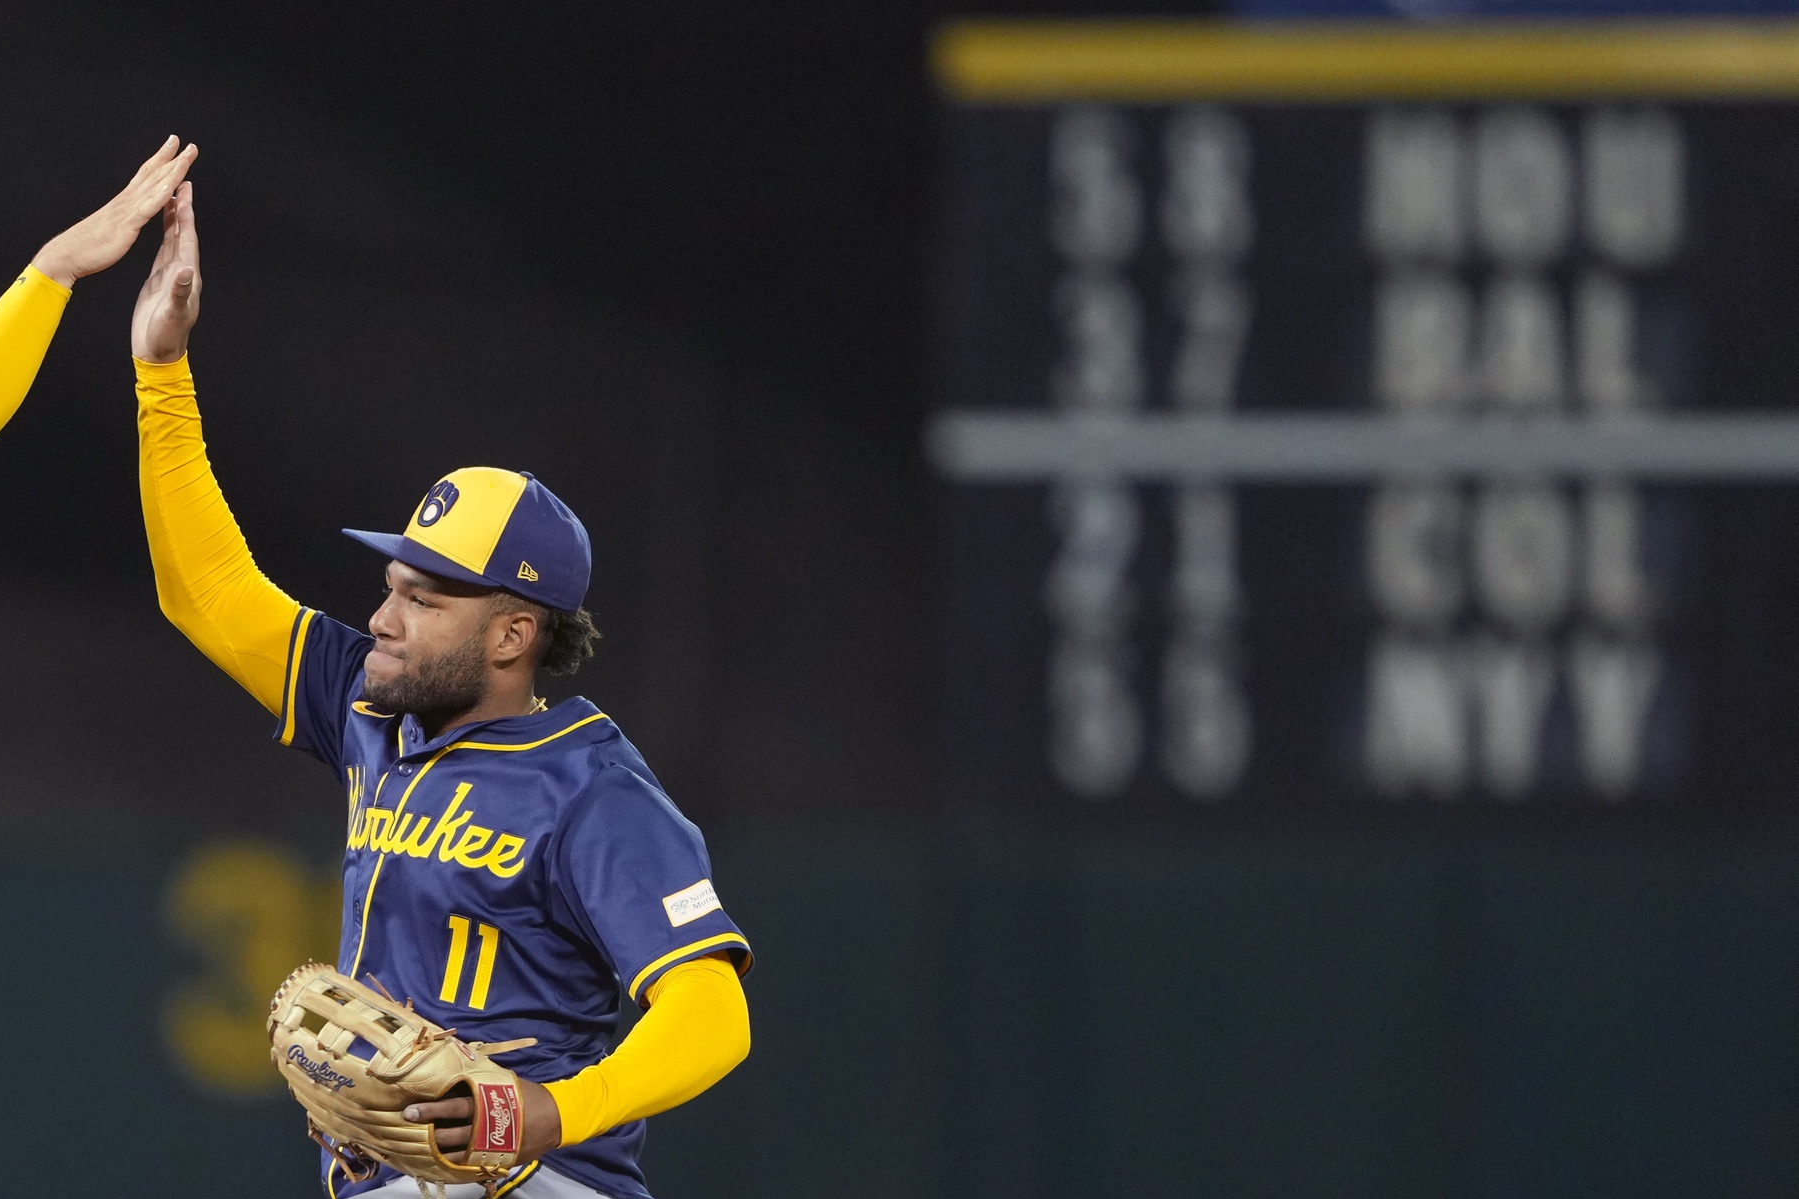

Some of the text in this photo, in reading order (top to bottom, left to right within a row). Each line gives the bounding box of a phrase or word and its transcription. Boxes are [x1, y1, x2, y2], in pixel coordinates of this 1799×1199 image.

[1365, 106, 1682, 266] HOU
[1374, 274, 1658, 418] BAL
[1366, 482, 1662, 628] COL
[1363, 642, 1660, 794] NYY
[166, 842, 344, 1090] 3
[439, 914, 499, 1011] 11
[287, 1044, 356, 1092] Rawlings
[489, 1089, 506, 1146] Rawlings
